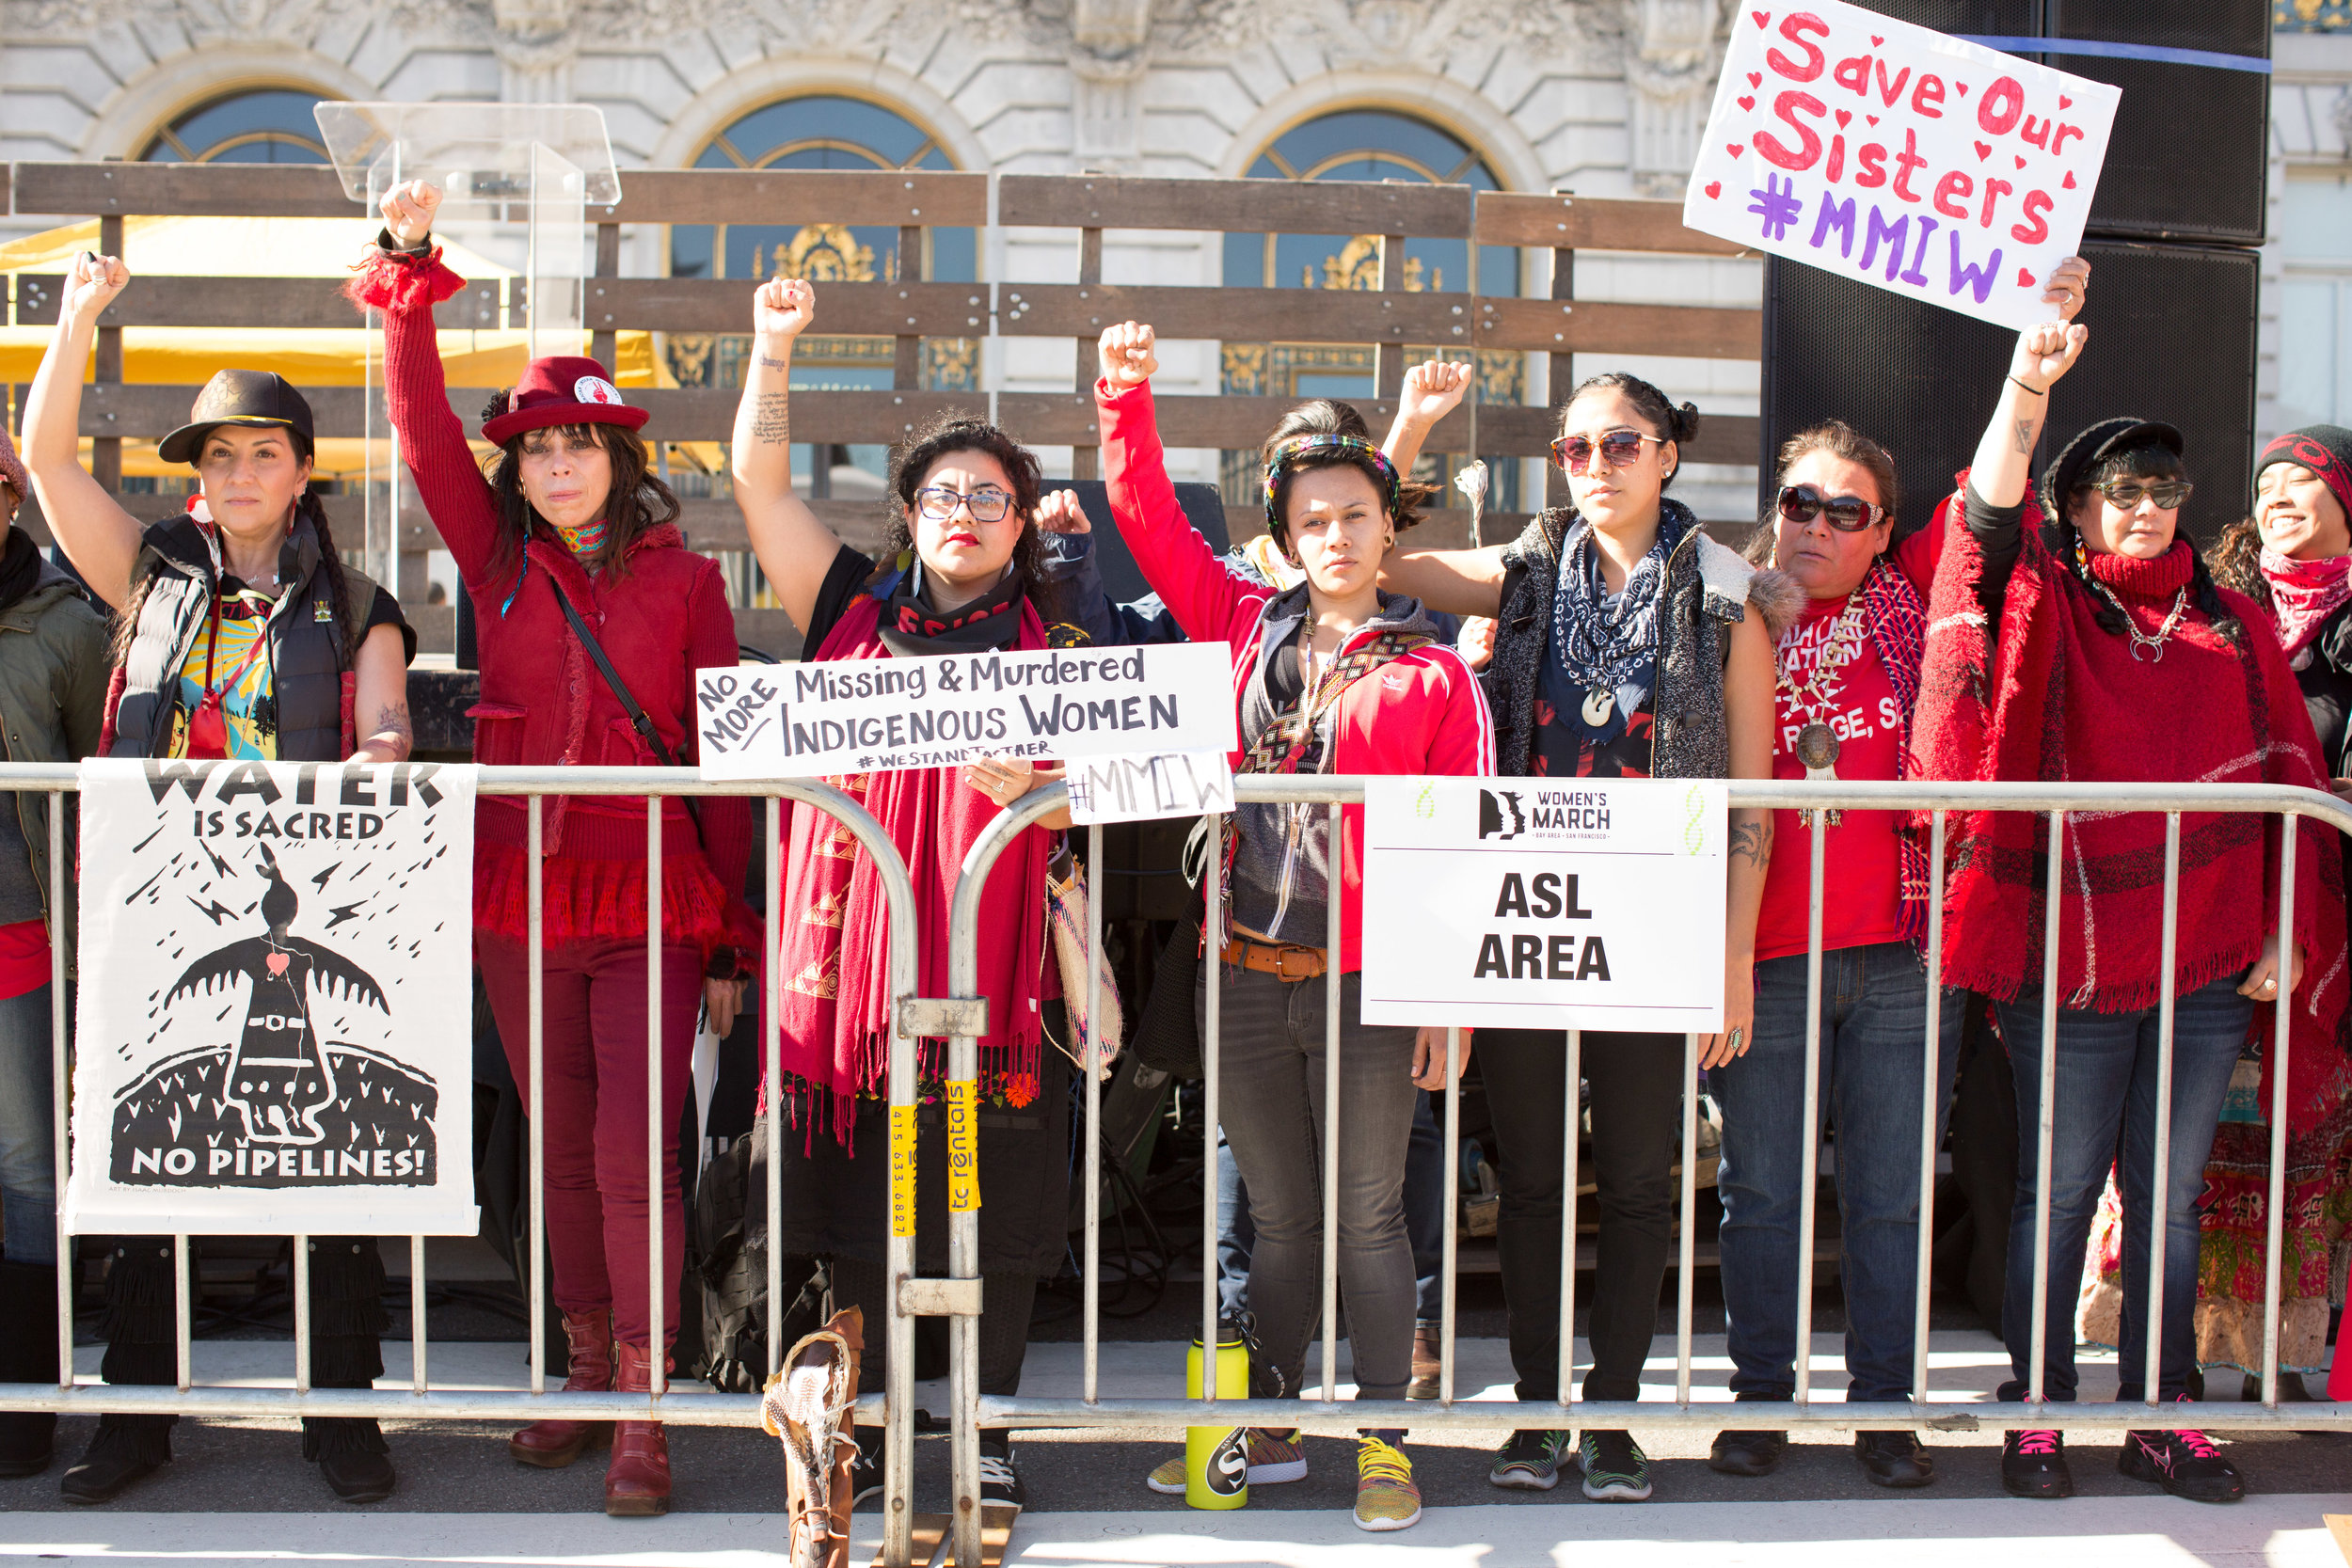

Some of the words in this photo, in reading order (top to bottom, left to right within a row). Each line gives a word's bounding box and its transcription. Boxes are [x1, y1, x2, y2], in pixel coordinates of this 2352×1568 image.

[1767, 11, 1946, 119] Save
[1978, 75, 2084, 155] Our
[1753, 90, 2054, 244] Sisters
[1747, 171, 2002, 304] #MMIW
[698, 674, 738, 712] NO
[796, 665, 927, 704] Missing
[938, 658, 963, 692] &
[970, 648, 1145, 691] Murdered
[703, 677, 778, 752] MORE
[781, 703, 1007, 756] INDIGENOUS
[1019, 693, 1179, 736] WOMEN
[1783, 707, 1873, 752] RGE,
[1879, 697, 1899, 729] S
[142, 759, 444, 808] WATER
[1069, 752, 1227, 813] #MMIW
[1538, 791, 1607, 806] WOMEN'S
[194, 811, 224, 837] IS
[236, 811, 383, 839] SACRED
[1533, 808, 1610, 830] MARCH
[1494, 873, 1592, 919] ASL
[1473, 933, 1612, 981] AREA
[131, 1148, 196, 1175] NO
[209, 1148, 425, 1176] PIPELINES!
[893, 1111, 905, 1233] 415.633.6827
[952, 1188, 969, 1209] tc
